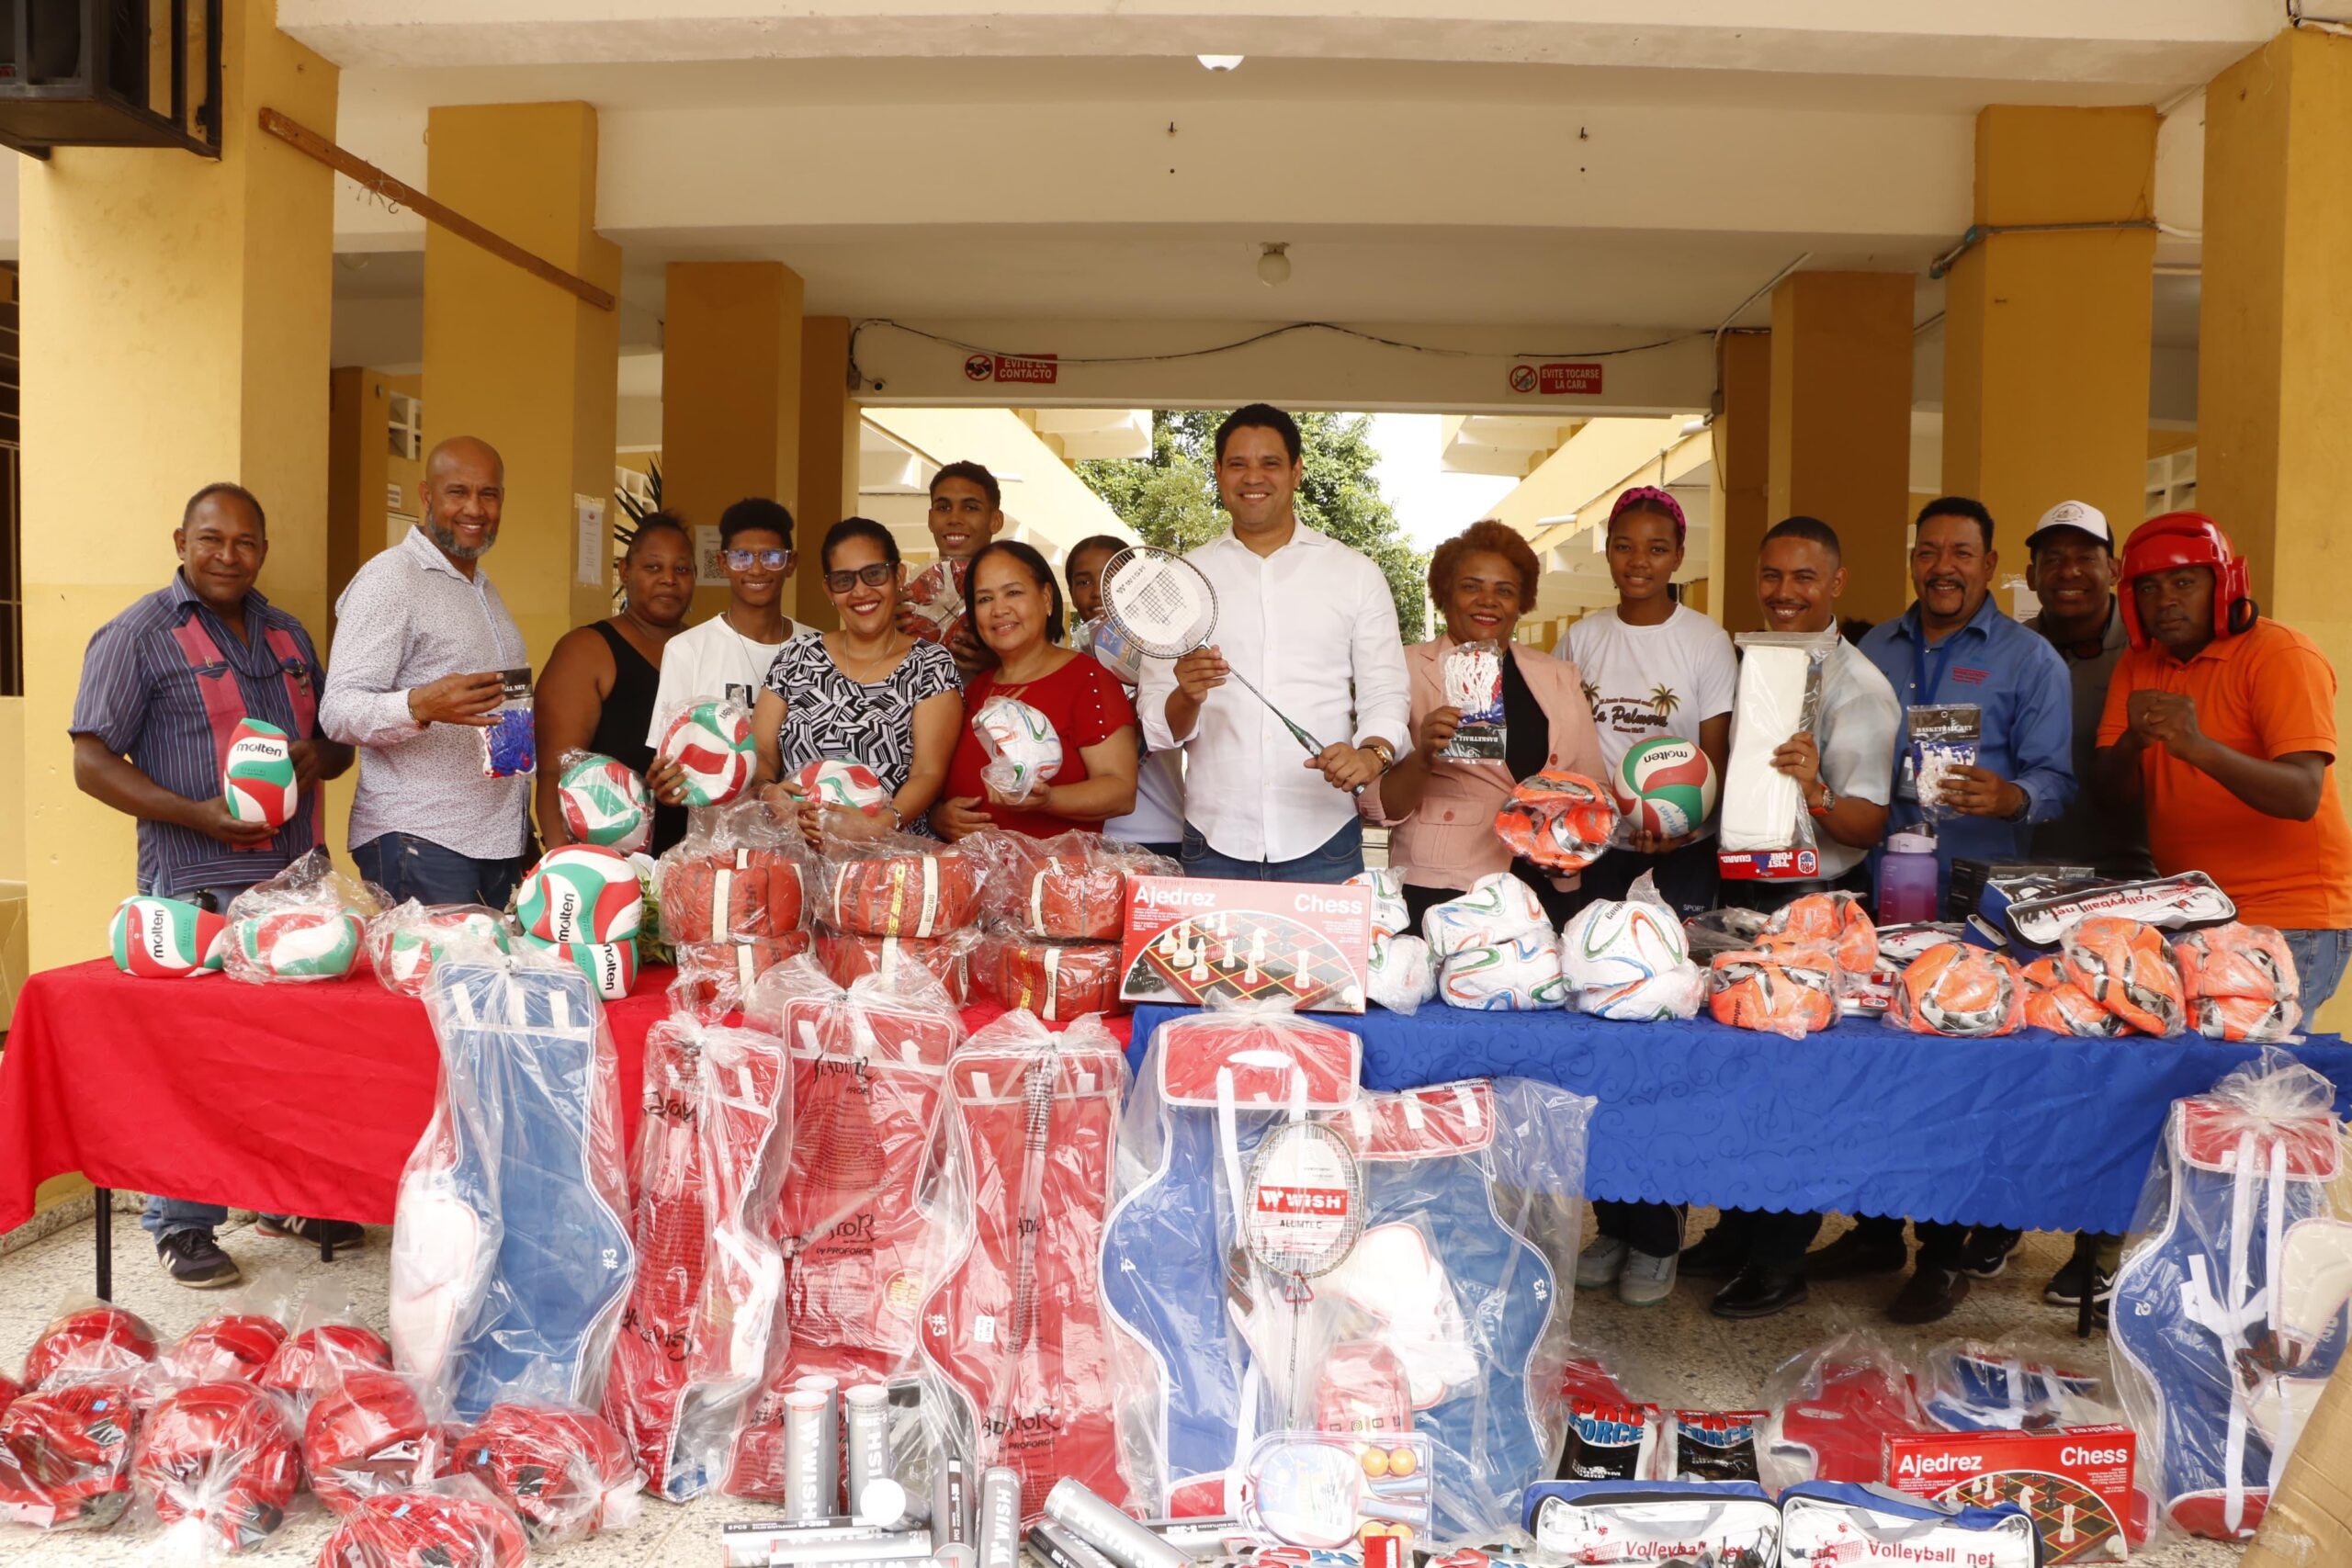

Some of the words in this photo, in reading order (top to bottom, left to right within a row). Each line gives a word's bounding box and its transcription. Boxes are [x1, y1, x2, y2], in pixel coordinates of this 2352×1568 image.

[1000, 368, 1052, 378] CONTACTO
[1004, 358, 1033, 368] EVITE
[1542, 369, 1565, 378] EVITE
[1566, 369, 1600, 378] TOCARSE
[1555, 379, 1565, 389] LA
[1566, 380, 1587, 389] CARA
[236, 742, 282, 757] molten
[1644, 750, 1688, 763] molten
[1133, 885, 1216, 908] Ajedrez
[1294, 893, 1363, 915] Chess
[1682, 903, 1706, 912] SPORT
[2082, 893, 2157, 915] Volleyball
[559, 892, 575, 942] molten
[1604, 901, 1626, 919] Coop
[151, 909, 164, 958] molten
[603, 942, 619, 990] molten
[1285, 1194, 1341, 1209] WISH
[603, 1248, 618, 1269] #3
[930, 1314, 947, 1337] #3
[1567, 1411, 1645, 1445] FORCE
[1898, 1452, 1982, 1478] Ajedrez
[2061, 1446, 2128, 1466] Chess
[801, 1451, 818, 1519] WISH
[996, 1486, 1012, 1540] WISH
[1868, 1540, 1956, 1563] Volleyball
[1966, 1551, 1996, 1567] net
